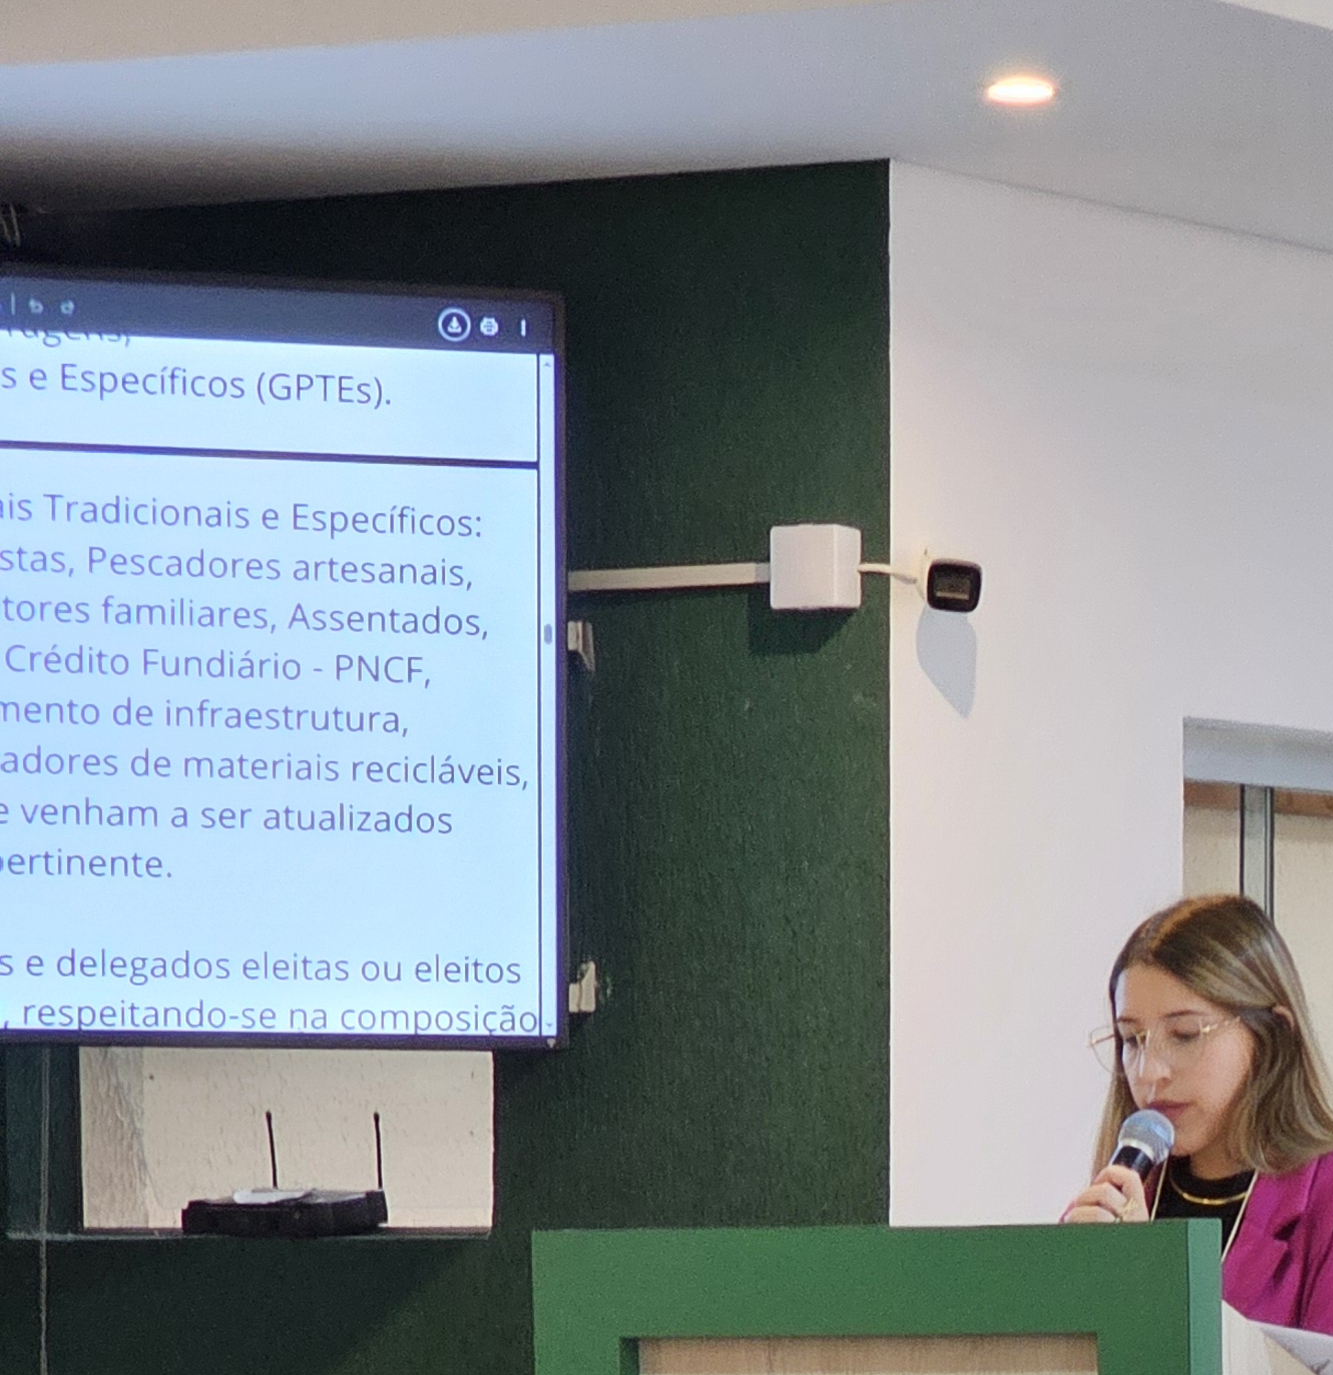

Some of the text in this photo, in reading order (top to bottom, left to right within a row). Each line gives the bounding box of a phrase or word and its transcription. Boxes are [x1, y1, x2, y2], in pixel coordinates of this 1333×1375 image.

[29, 368, 48, 391] e
[60, 363, 246, 402] Específicos
[256, 371, 391, 410] (GPTEs).
[0, 492, 482, 540] is Tradicionais e Específicos:
[0, 546, 472, 592] stas, Pescadores artesanais,
[1, 595, 488, 641] tores familiares, Assentados,
[5, 643, 130, 676] Crédito
[143, 648, 301, 681] Fundiário
[336, 654, 431, 690] PNCF,
[112, 696, 154, 727] de
[166, 698, 409, 738] infraestrutura,
[0, 744, 528, 791] adores de materiais recicláveis,
[20, 797, 158, 827] venham
[170, 806, 189, 828] a
[200, 807, 253, 829] ser
[263, 802, 453, 835] atualizados
[0, 848, 172, 879] ertinente.
[26, 954, 45, 977] e
[56, 947, 231, 986] delegados
[242, 950, 349, 982] eleitas
[361, 960, 402, 982] ou
[414, 953, 522, 985] eleitos
[23, 999, 538, 1034] respeitando-se na composição
